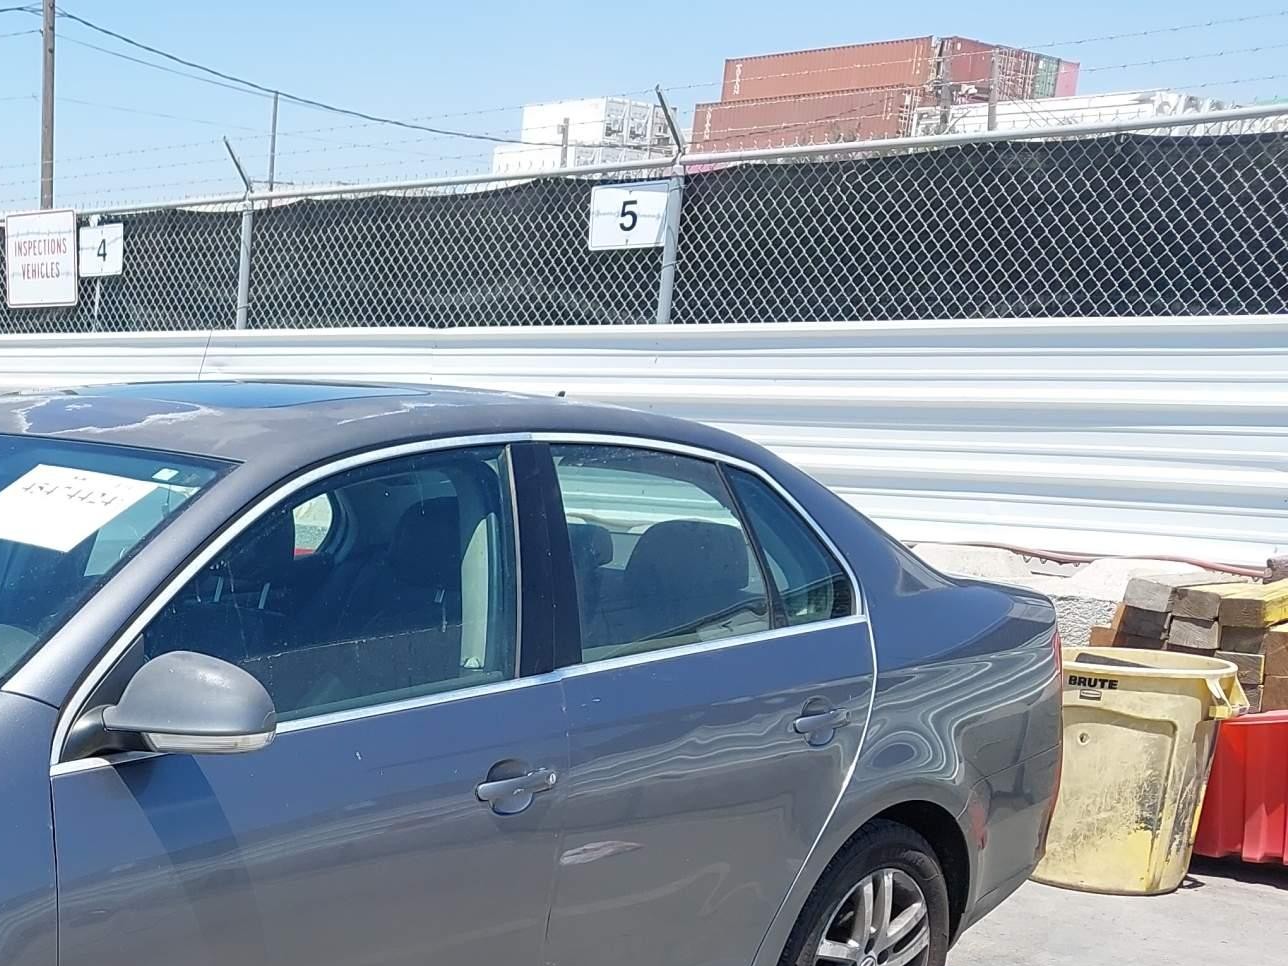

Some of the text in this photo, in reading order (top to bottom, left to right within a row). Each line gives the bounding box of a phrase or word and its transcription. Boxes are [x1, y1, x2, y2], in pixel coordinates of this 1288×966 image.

[619, 199, 638, 232] 5
[14, 238, 67, 257] INSPECTIONS
[96, 238, 107, 262] 4
[21, 262, 61, 280] VEHICLES
[1068, 675, 1119, 690] BRUTE
